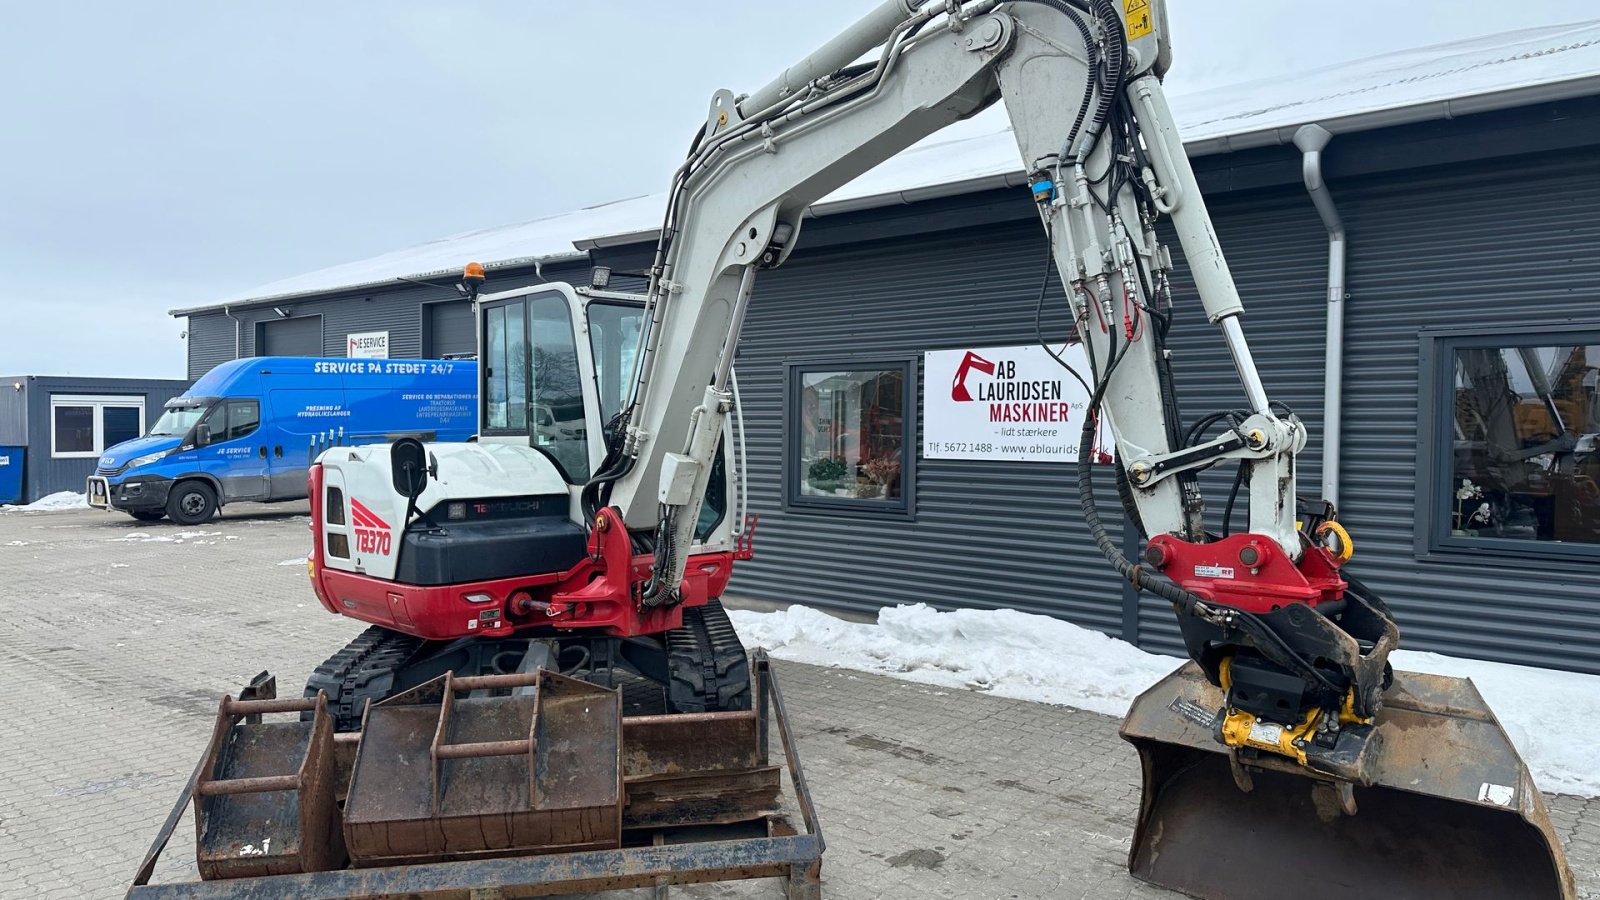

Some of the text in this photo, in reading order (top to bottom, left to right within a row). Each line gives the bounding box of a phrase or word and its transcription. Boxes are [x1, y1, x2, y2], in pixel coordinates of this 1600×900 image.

[356, 336, 386, 349] JE SERVICE
[314, 360, 454, 375] SERVICE PÅ STEDET 24/7
[996, 360, 1016, 380] AB
[978, 380, 1062, 402] LAURIDSEN
[989, 402, 1083, 423] MASKINER ApS
[1000, 427, 1015, 437] lidt
[1017, 428, 1058, 437] stærkere
[928, 442, 943, 453] Tlf.
[944, 443, 967, 453] 5672
[969, 443, 993, 453] 1488
[354, 528, 391, 556] TB370
